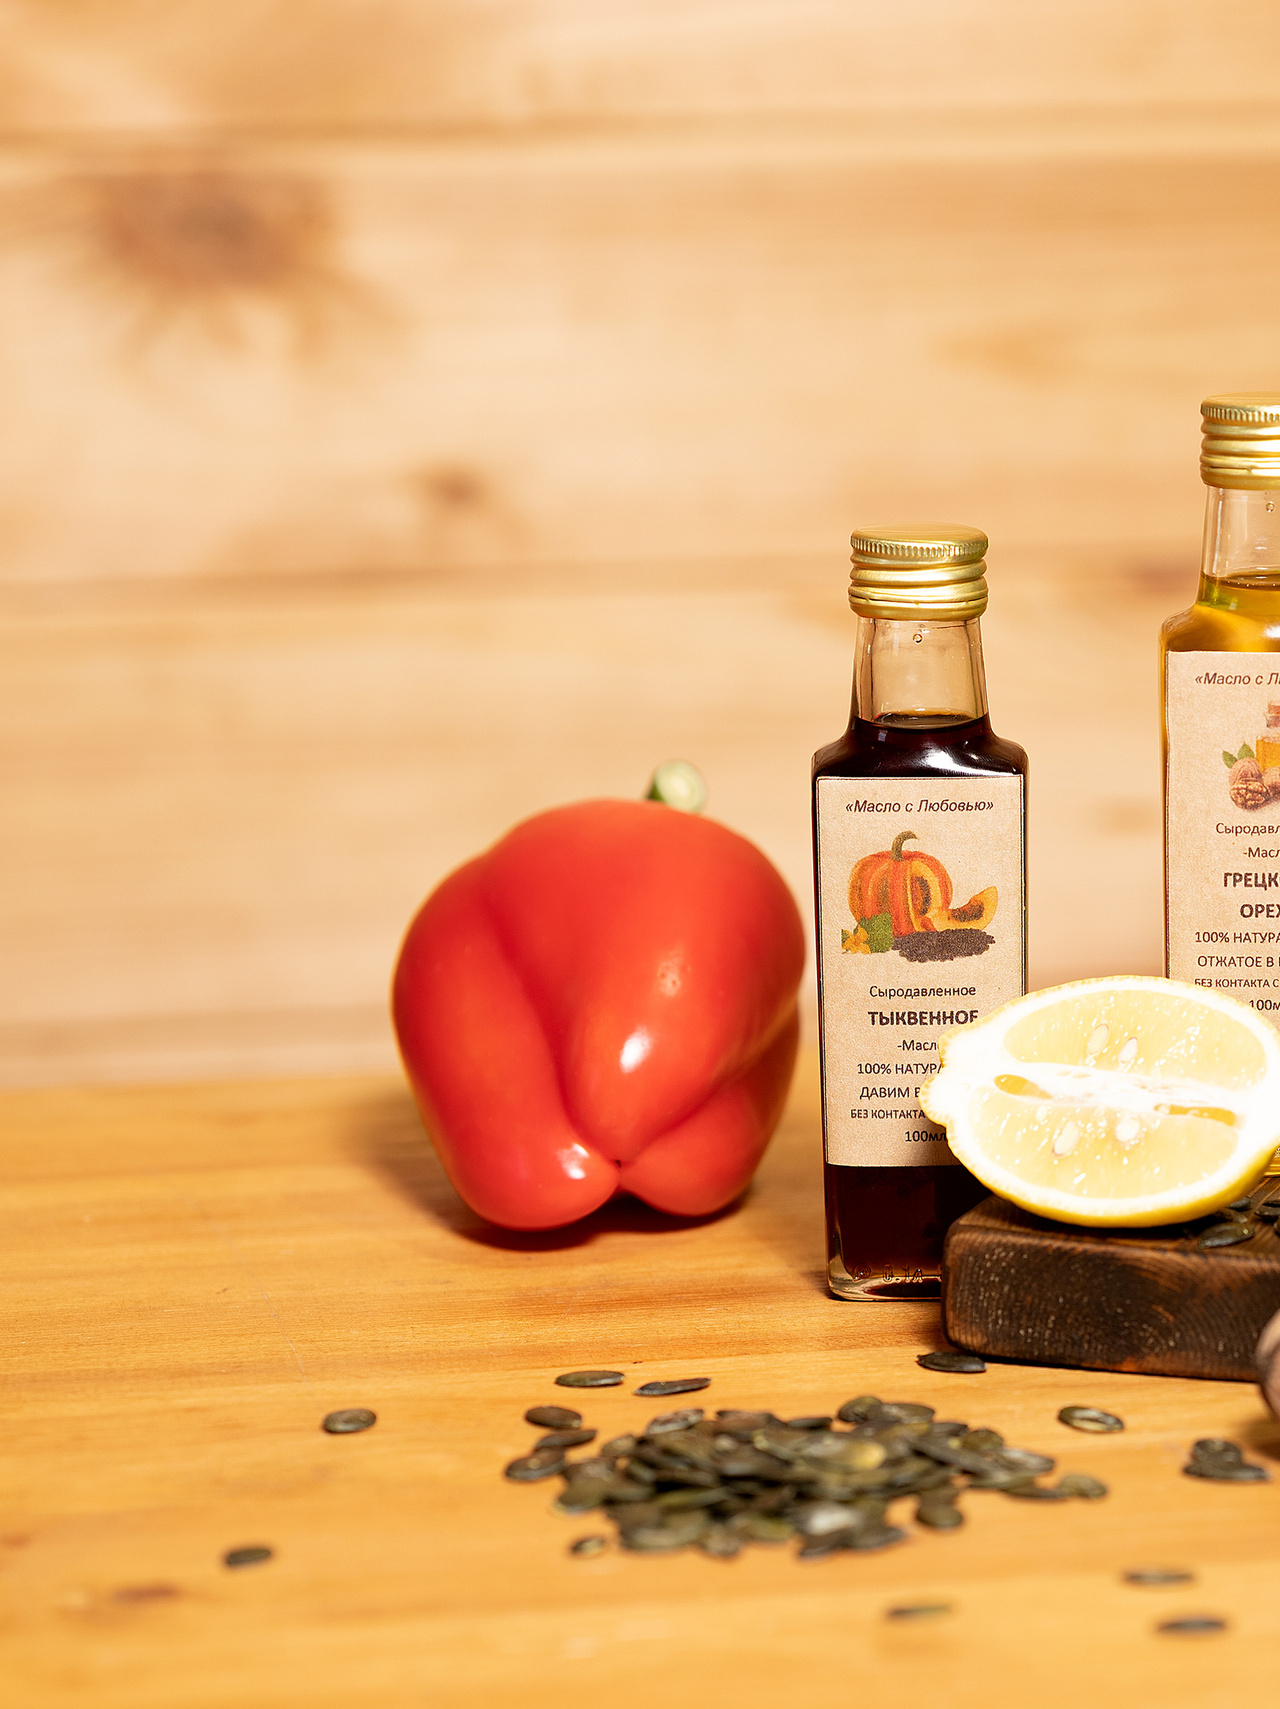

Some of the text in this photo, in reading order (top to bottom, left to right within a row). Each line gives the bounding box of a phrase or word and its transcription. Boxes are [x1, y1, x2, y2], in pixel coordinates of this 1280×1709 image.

[1195, 672, 1250, 685] «Масло
[1255, 675, 1263, 685] с
[845, 799, 994, 813] «Масло с Любовью»
[1195, 931, 1230, 943] 100%
[1197, 955, 1262, 968] ОТЖАТОЕ
[1266, 955, 1275, 968] В
[1194, 978, 1213, 988] БЕЗ
[1215, 978, 1270, 988] КОНТАКТА
[1272, 978, 1279, 988] С
[869, 985, 977, 999] Сыродавленное
[897, 1040, 939, 1051] -Масл
[857, 1063, 892, 1075] 100%
[859, 1087, 910, 1100] ДАВИМ
[850, 1109, 926, 1119] БЕЗ КОНТАКТА
[905, 1130, 946, 1142] 100мл
